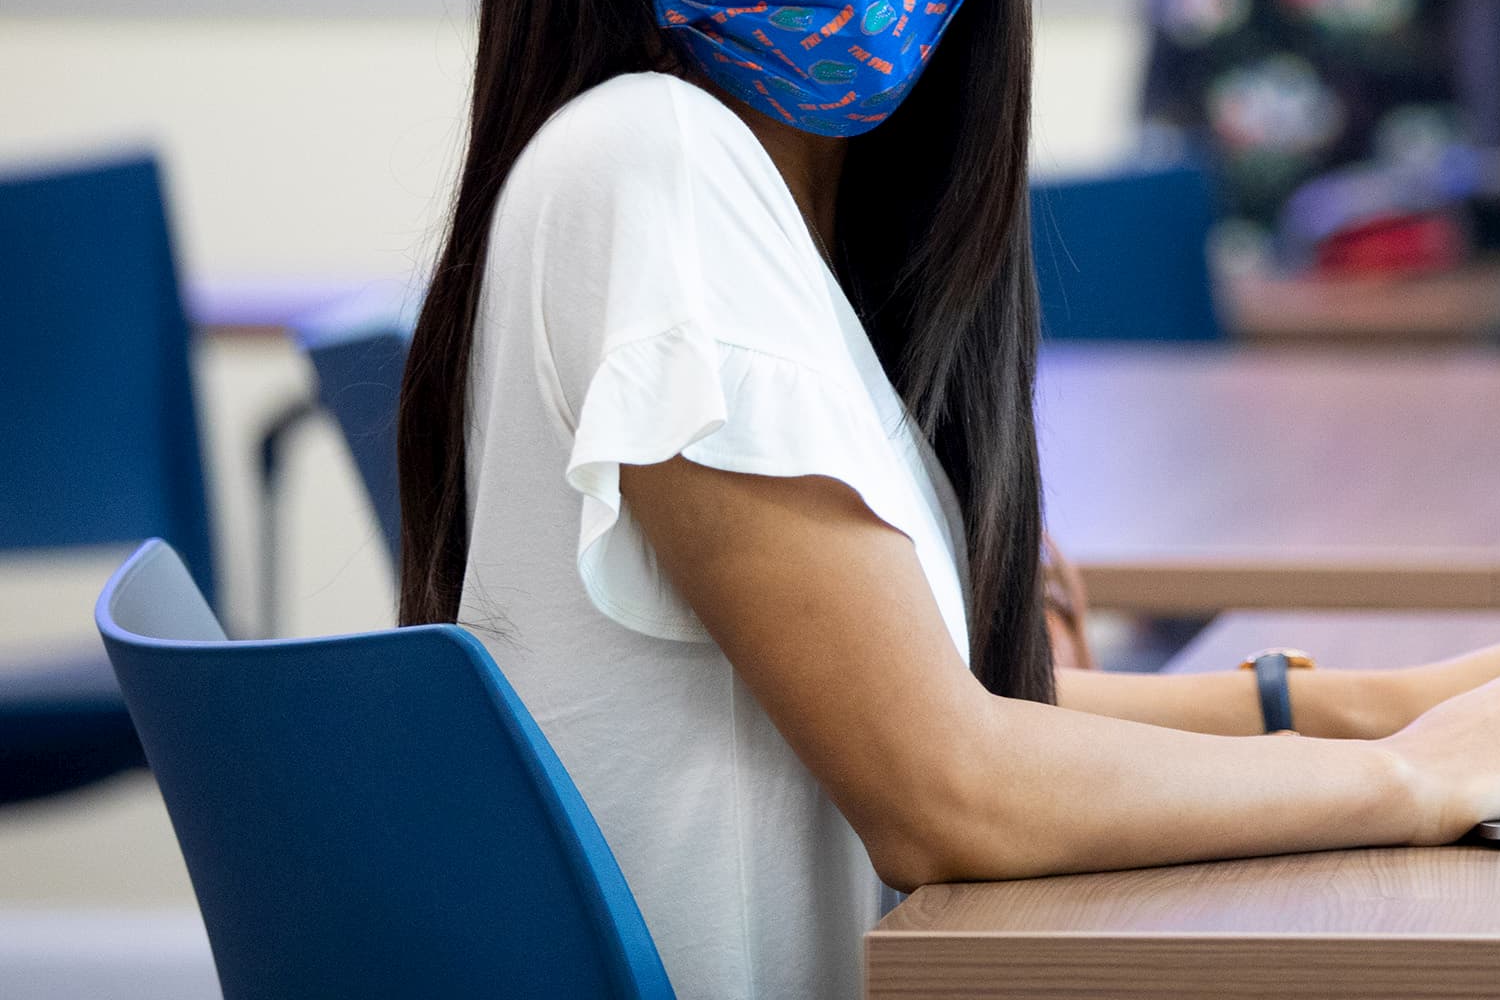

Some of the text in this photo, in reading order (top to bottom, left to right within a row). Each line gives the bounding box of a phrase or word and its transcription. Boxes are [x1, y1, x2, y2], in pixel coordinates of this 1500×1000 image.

[800, 5, 854, 51] THE SWAMP
[848, 45, 872, 62] THE
